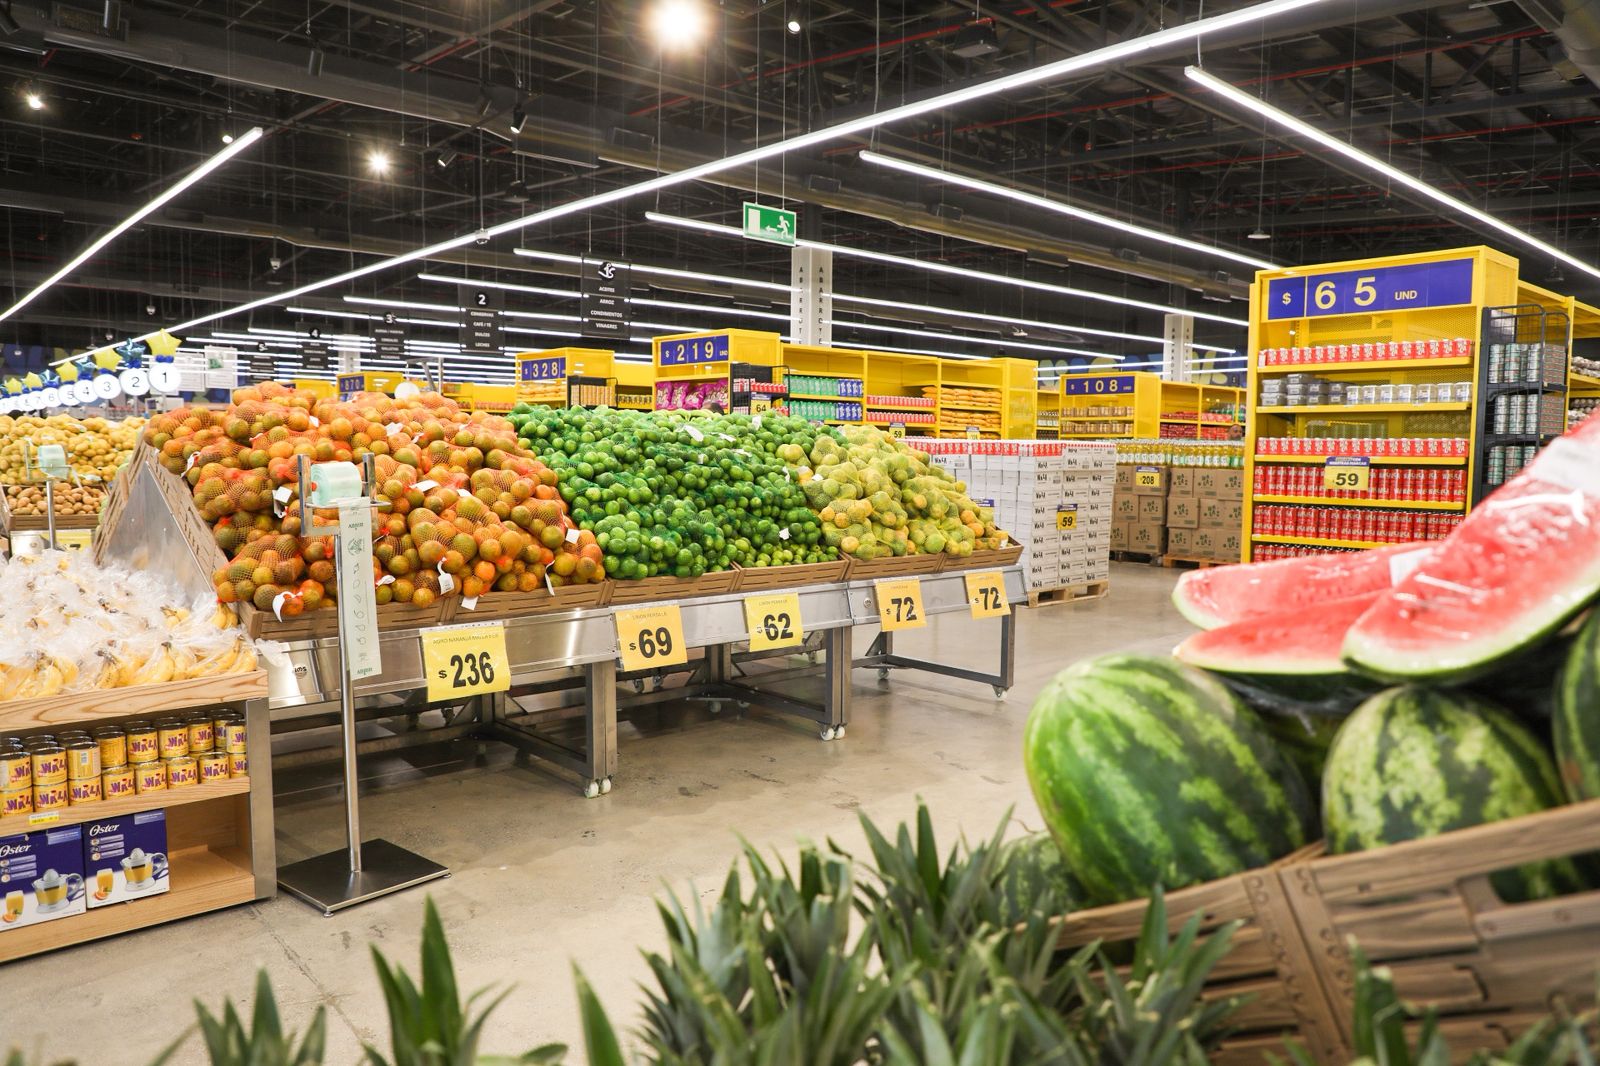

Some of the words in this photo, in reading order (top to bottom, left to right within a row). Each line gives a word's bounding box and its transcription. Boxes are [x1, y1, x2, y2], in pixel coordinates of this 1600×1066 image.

[478, 294, 486, 305] 2
[1282, 292, 1291, 305] $
[1394, 290, 1418, 300] UND
[590, 309, 622, 318] CONDIMENTOS
[595, 322, 618, 330] VINAGRES
[311, 328, 319, 338] 4
[676, 340, 714, 362] 219
[532, 361, 558, 378] 328
[131, 376, 140, 388] 2
[162, 371, 167, 384] 1
[103, 381, 112, 392] 3
[1082, 379, 1118, 393] 108
[1142, 475, 1155, 485] 208
[1335, 472, 1359, 486] 59
[1062, 516, 1073, 527] 59
[89, 823, 120, 837] Oster
[0, 844, 31, 858] Oster
